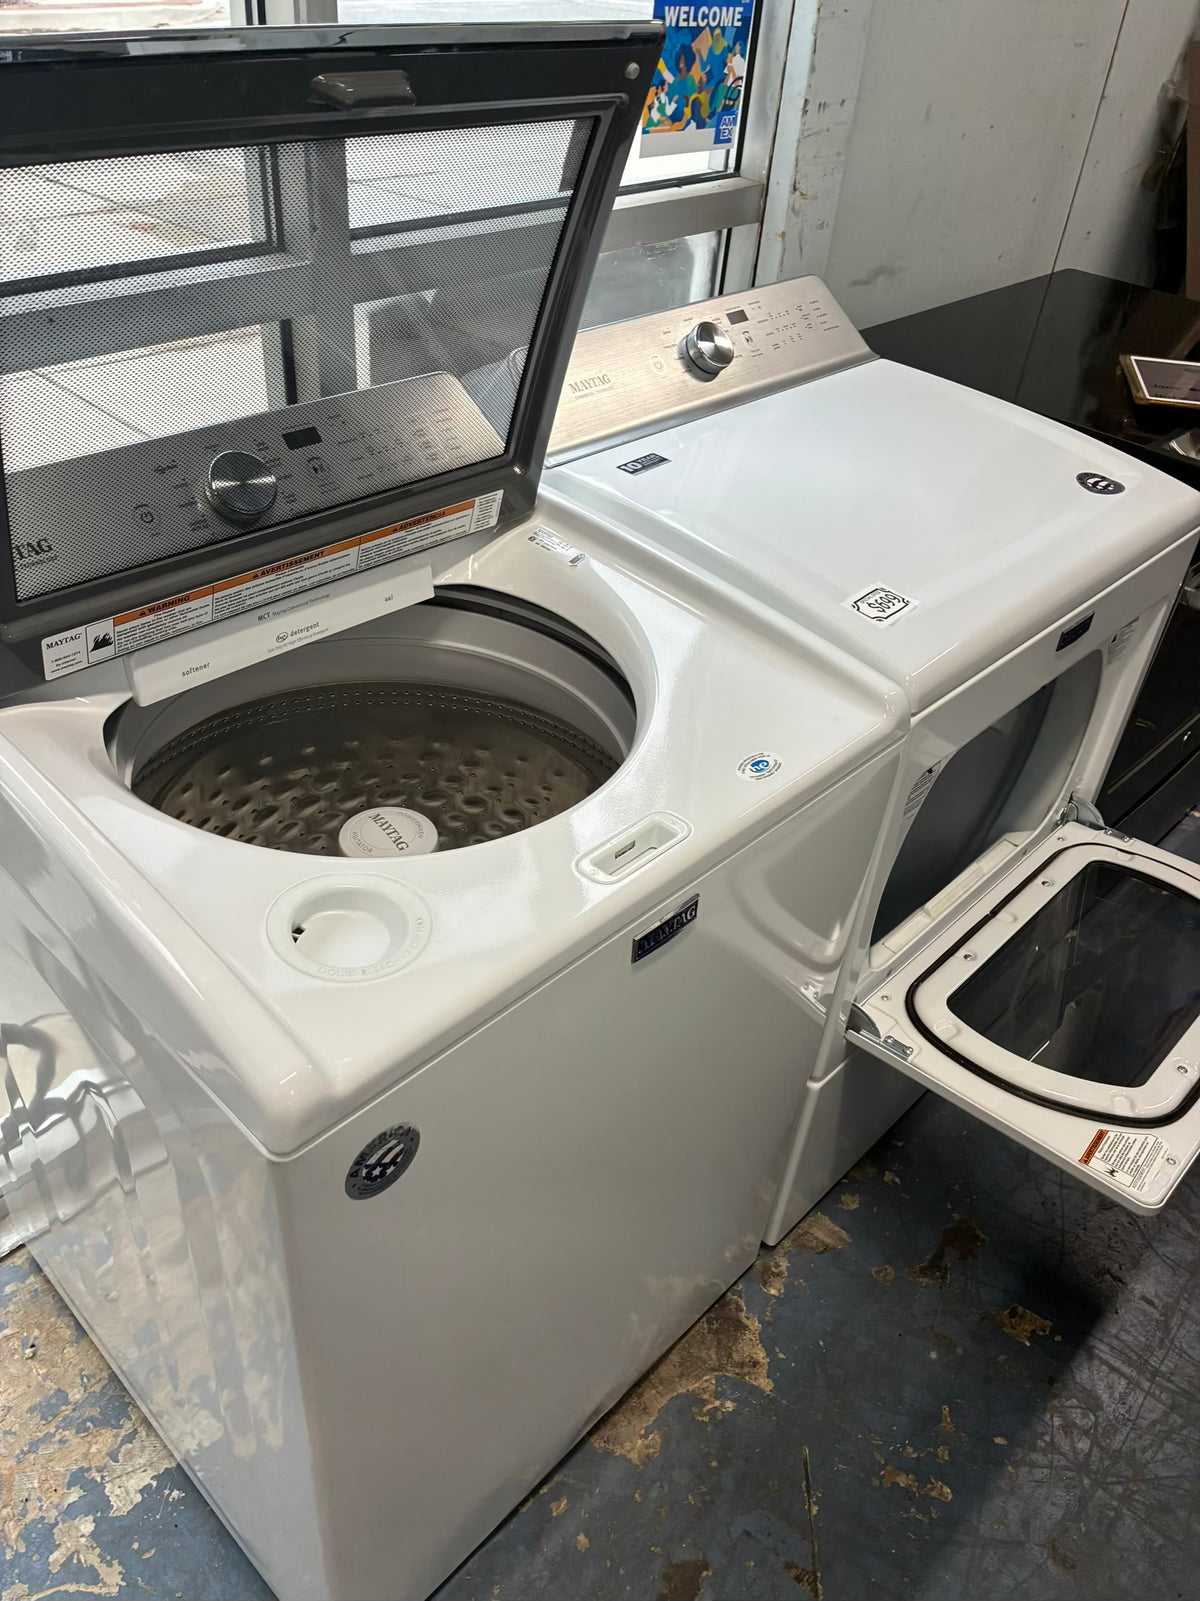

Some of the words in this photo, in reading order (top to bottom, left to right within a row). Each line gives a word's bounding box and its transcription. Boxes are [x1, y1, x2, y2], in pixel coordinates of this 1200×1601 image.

[664, 6, 744, 27] WELCOME
[568, 374, 611, 394] MAYTAG
[620, 461, 643, 472] 10
[399, 510, 446, 531] ADVERTENCIA
[12, 539, 53, 560] TAG
[260, 551, 325, 576] AVERTISSEMENT
[147, 595, 190, 614] WARNING
[866, 594, 900, 613] $699
[257, 612, 271, 622] MCT
[290, 621, 320, 637] detergent
[46, 634, 81, 650] MAYTAG
[181, 661, 211, 677] softener
[368, 813, 410, 851] MAYTAG
